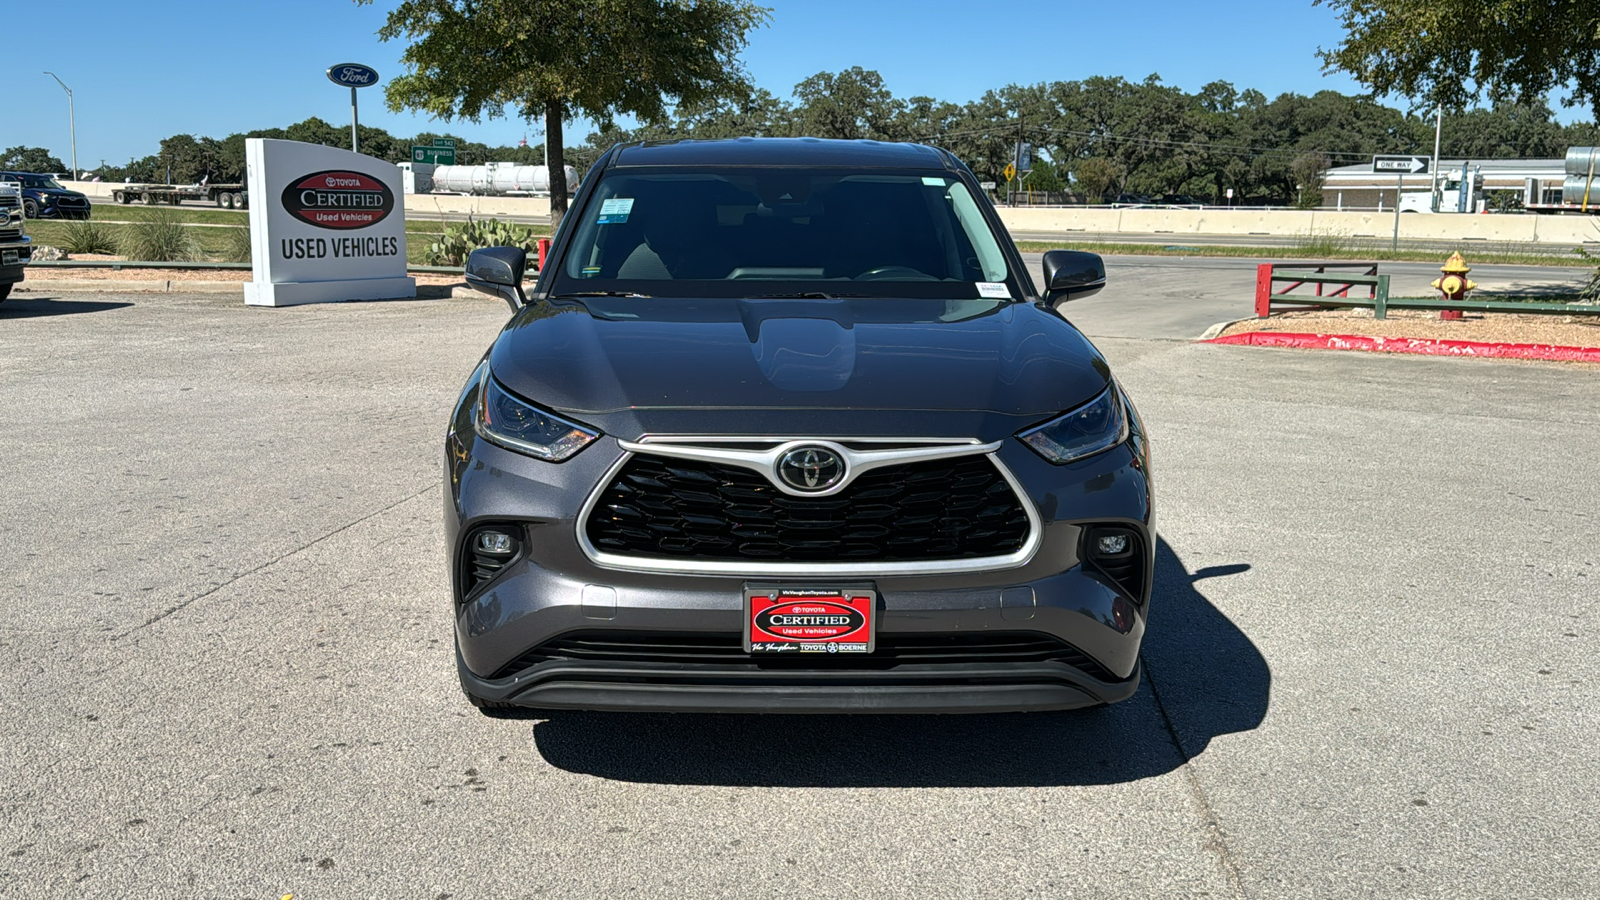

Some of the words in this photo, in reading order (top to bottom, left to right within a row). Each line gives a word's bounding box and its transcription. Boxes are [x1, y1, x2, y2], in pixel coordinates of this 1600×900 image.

[340, 67, 370, 84] Ford
[336, 178, 360, 187] TOYOTA
[300, 189, 383, 207] CERTIFIED
[316, 213, 338, 222] Used
[340, 212, 372, 221] Vehicles
[281, 238, 327, 259] USED
[331, 236, 398, 258] VEHICLES
[769, 614, 850, 625] CERTIFIED
[765, 643, 798, 652] Vaughan
